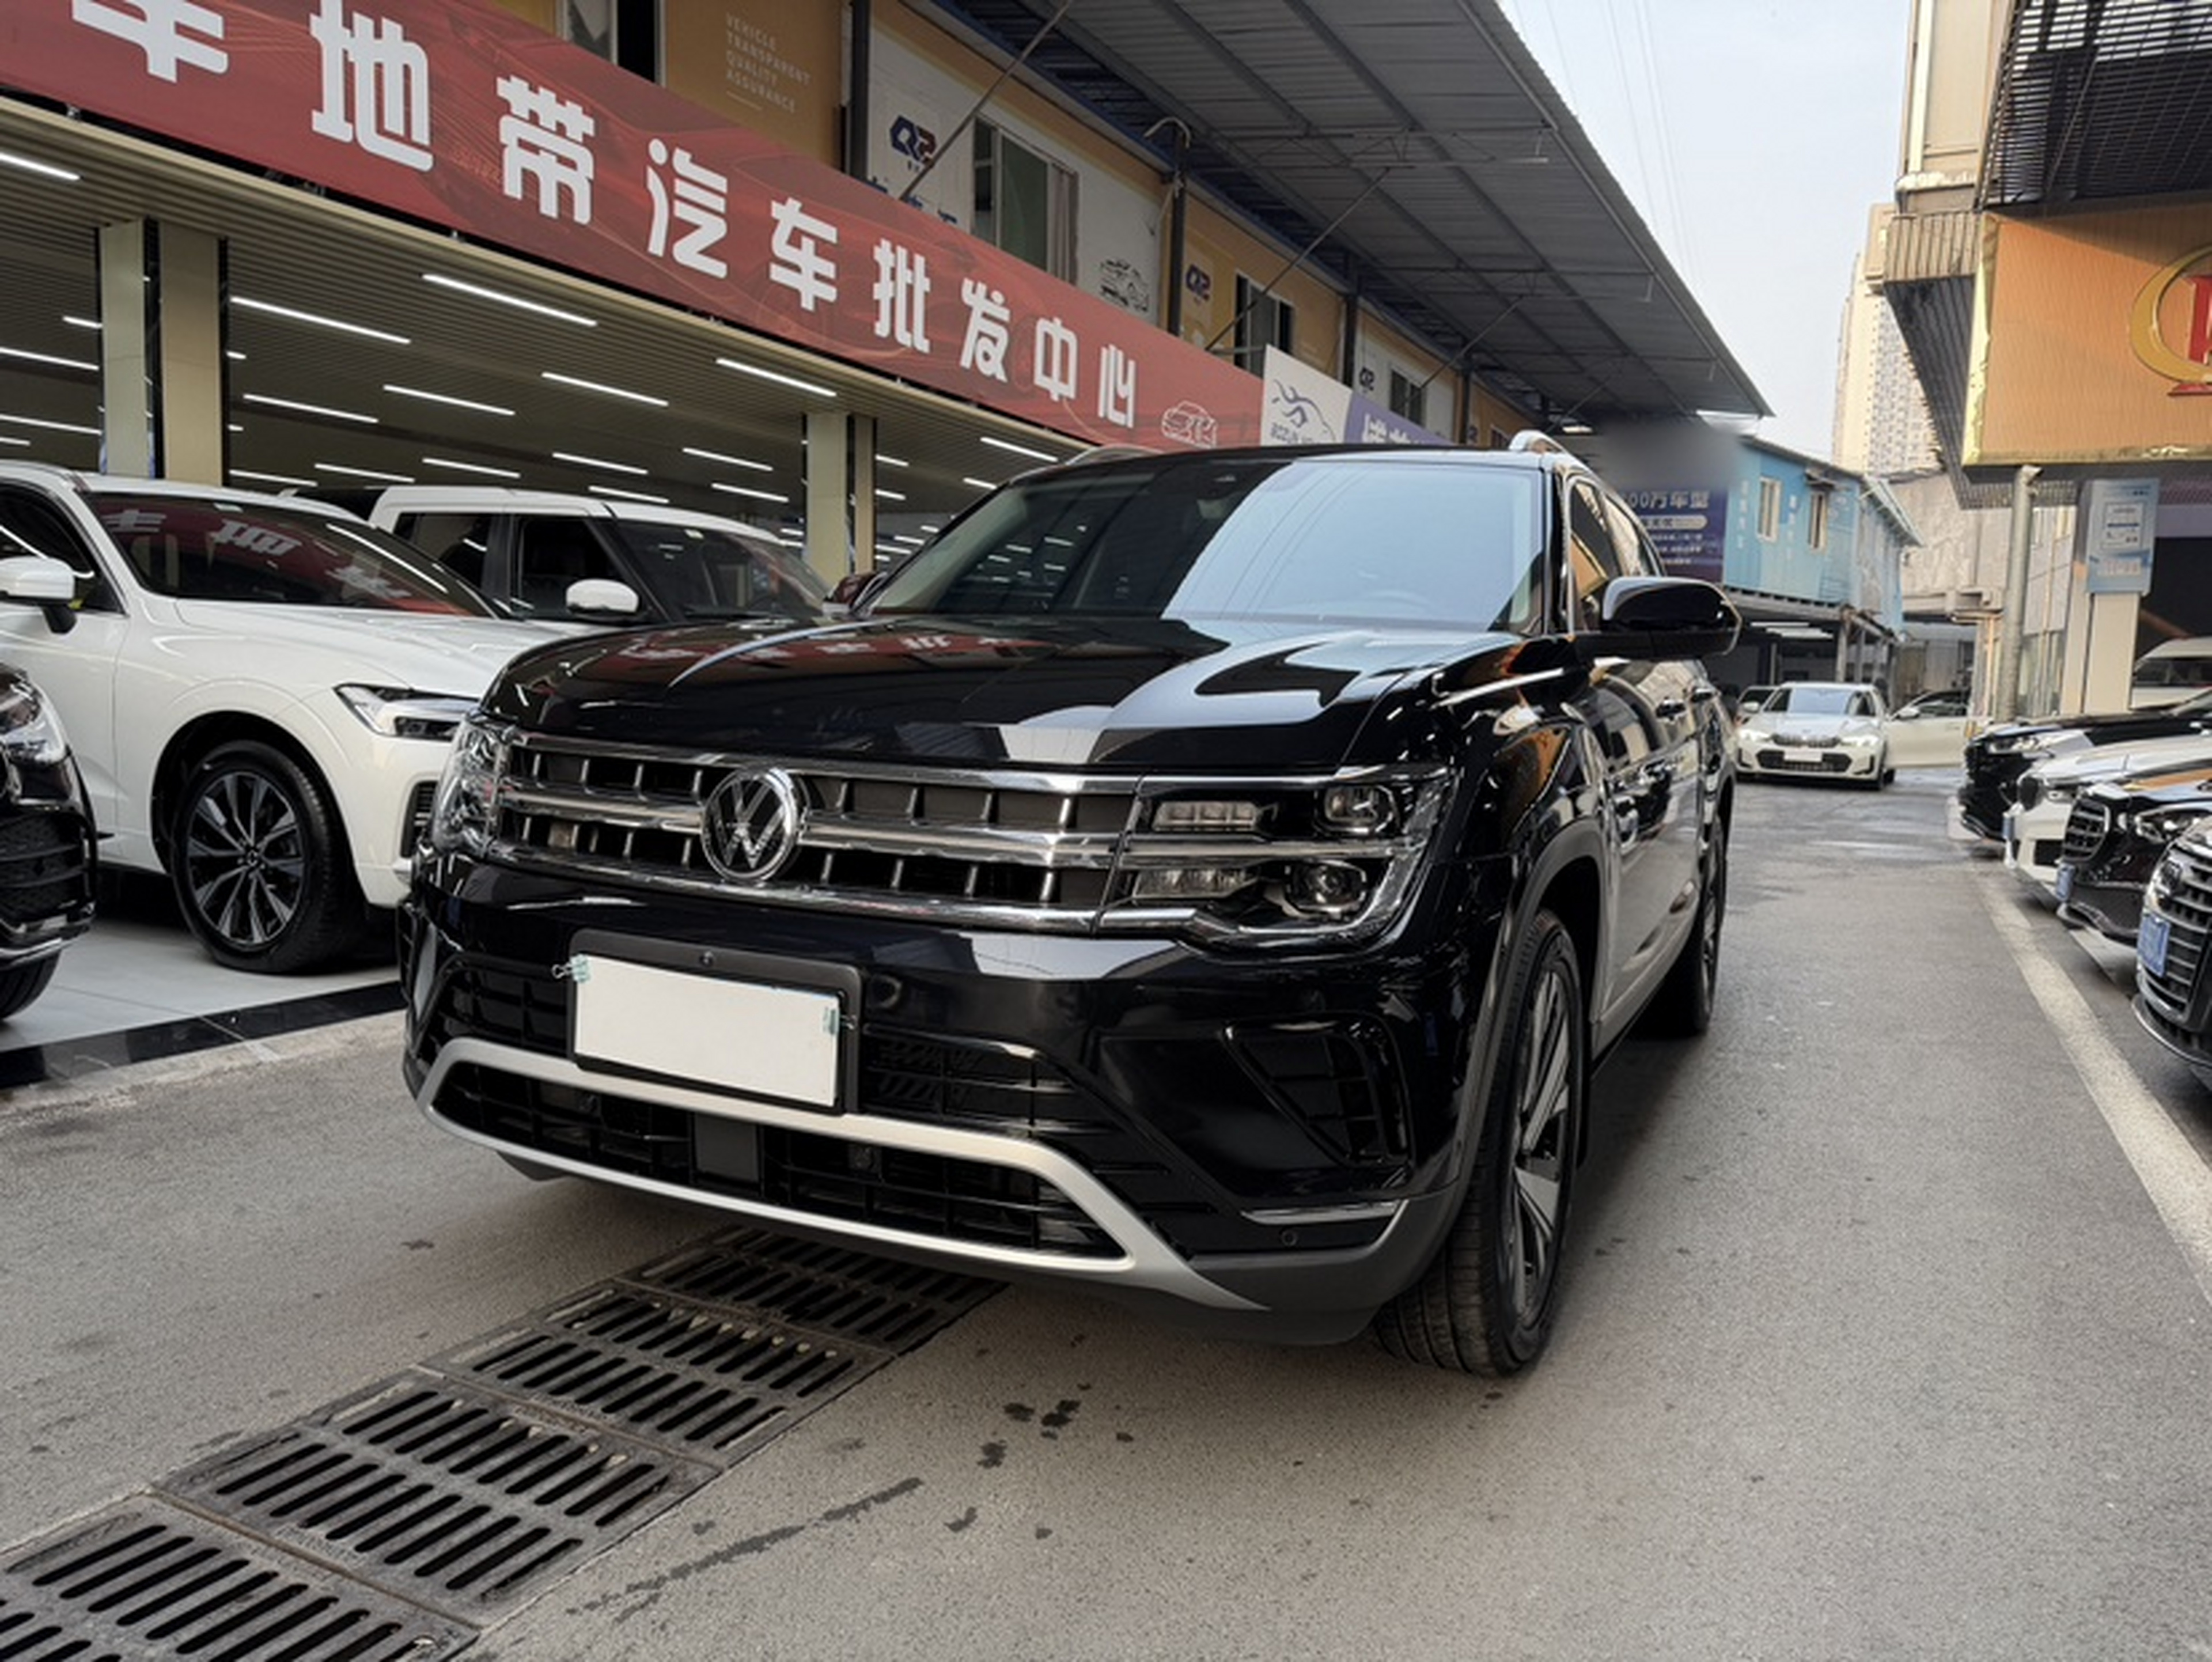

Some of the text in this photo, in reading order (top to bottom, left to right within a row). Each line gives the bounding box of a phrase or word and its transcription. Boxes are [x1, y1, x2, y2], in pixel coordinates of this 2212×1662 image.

[726, 13, 776, 52] VEHICLE
[726, 30, 811, 85] TRANSPARENT
[726, 50, 778, 86] QUALITY
[726, 69, 796, 113] ASSURANCE
